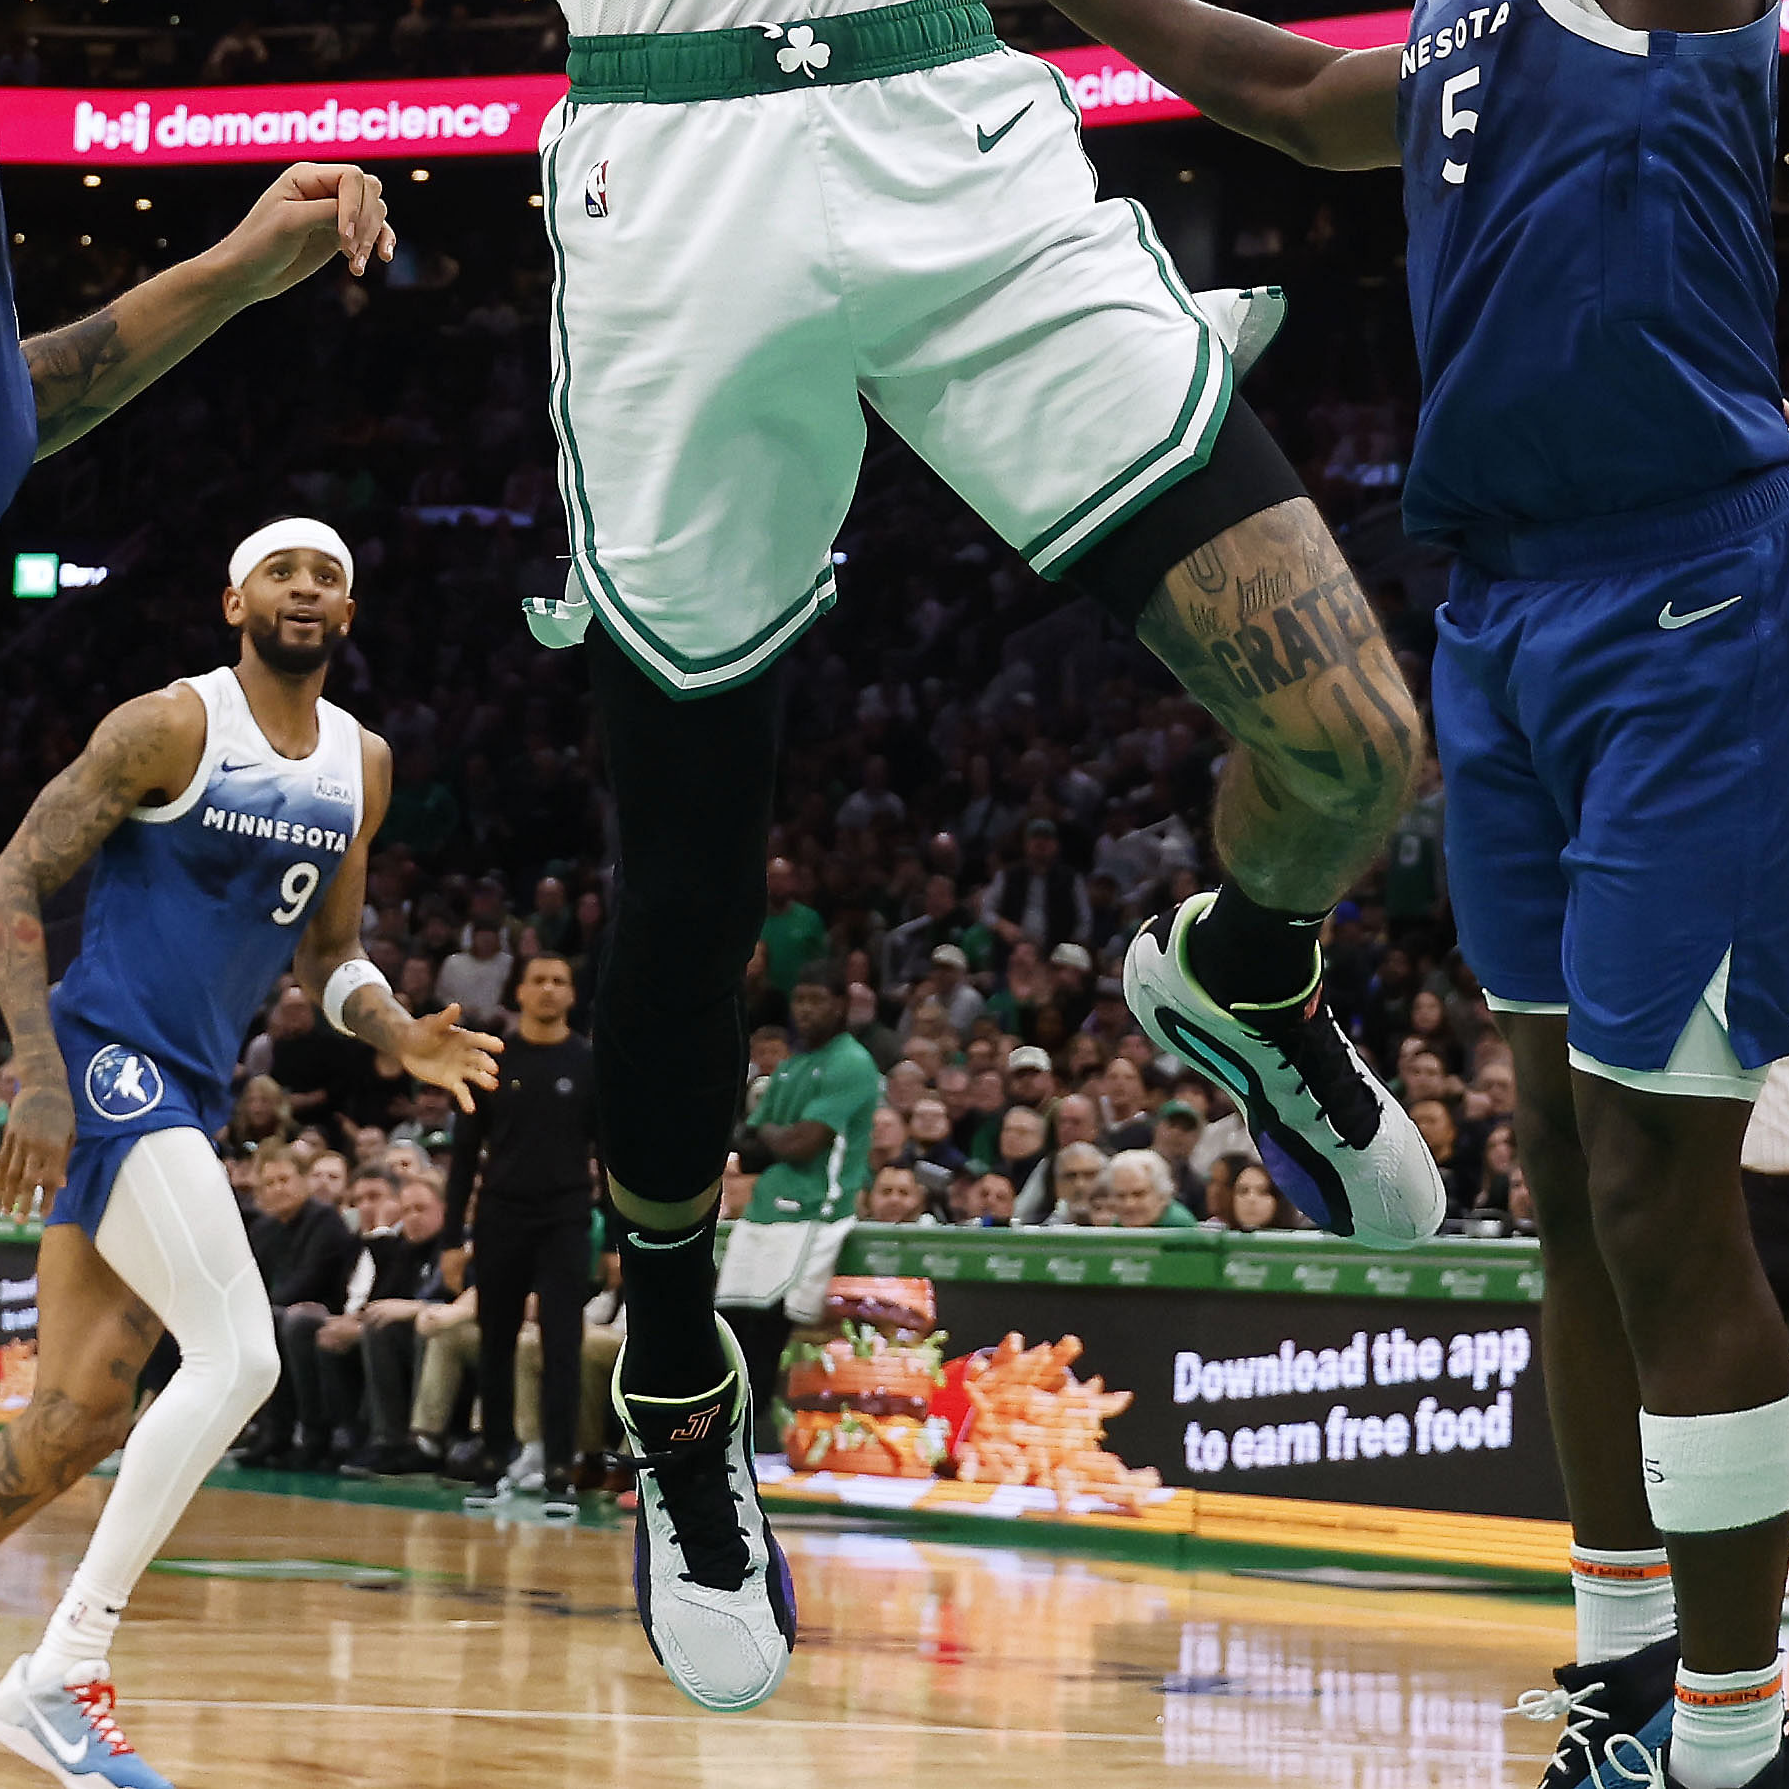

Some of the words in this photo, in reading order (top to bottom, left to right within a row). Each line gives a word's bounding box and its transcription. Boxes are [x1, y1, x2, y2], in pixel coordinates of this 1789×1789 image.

[155, 97, 511, 149] demandscience
[1440, 65, 1482, 185] 5
[202, 806, 347, 855] MINNESOTA
[270, 861, 320, 927] 9
[1173, 1331, 1368, 1404] Download
[1371, 1326, 1444, 1386] the
[1447, 1326, 1532, 1391] app
[1183, 1420, 1228, 1473] to
[1230, 1420, 1322, 1470] earn
[1324, 1404, 1410, 1461] free
[1414, 1388, 1513, 1456] food
